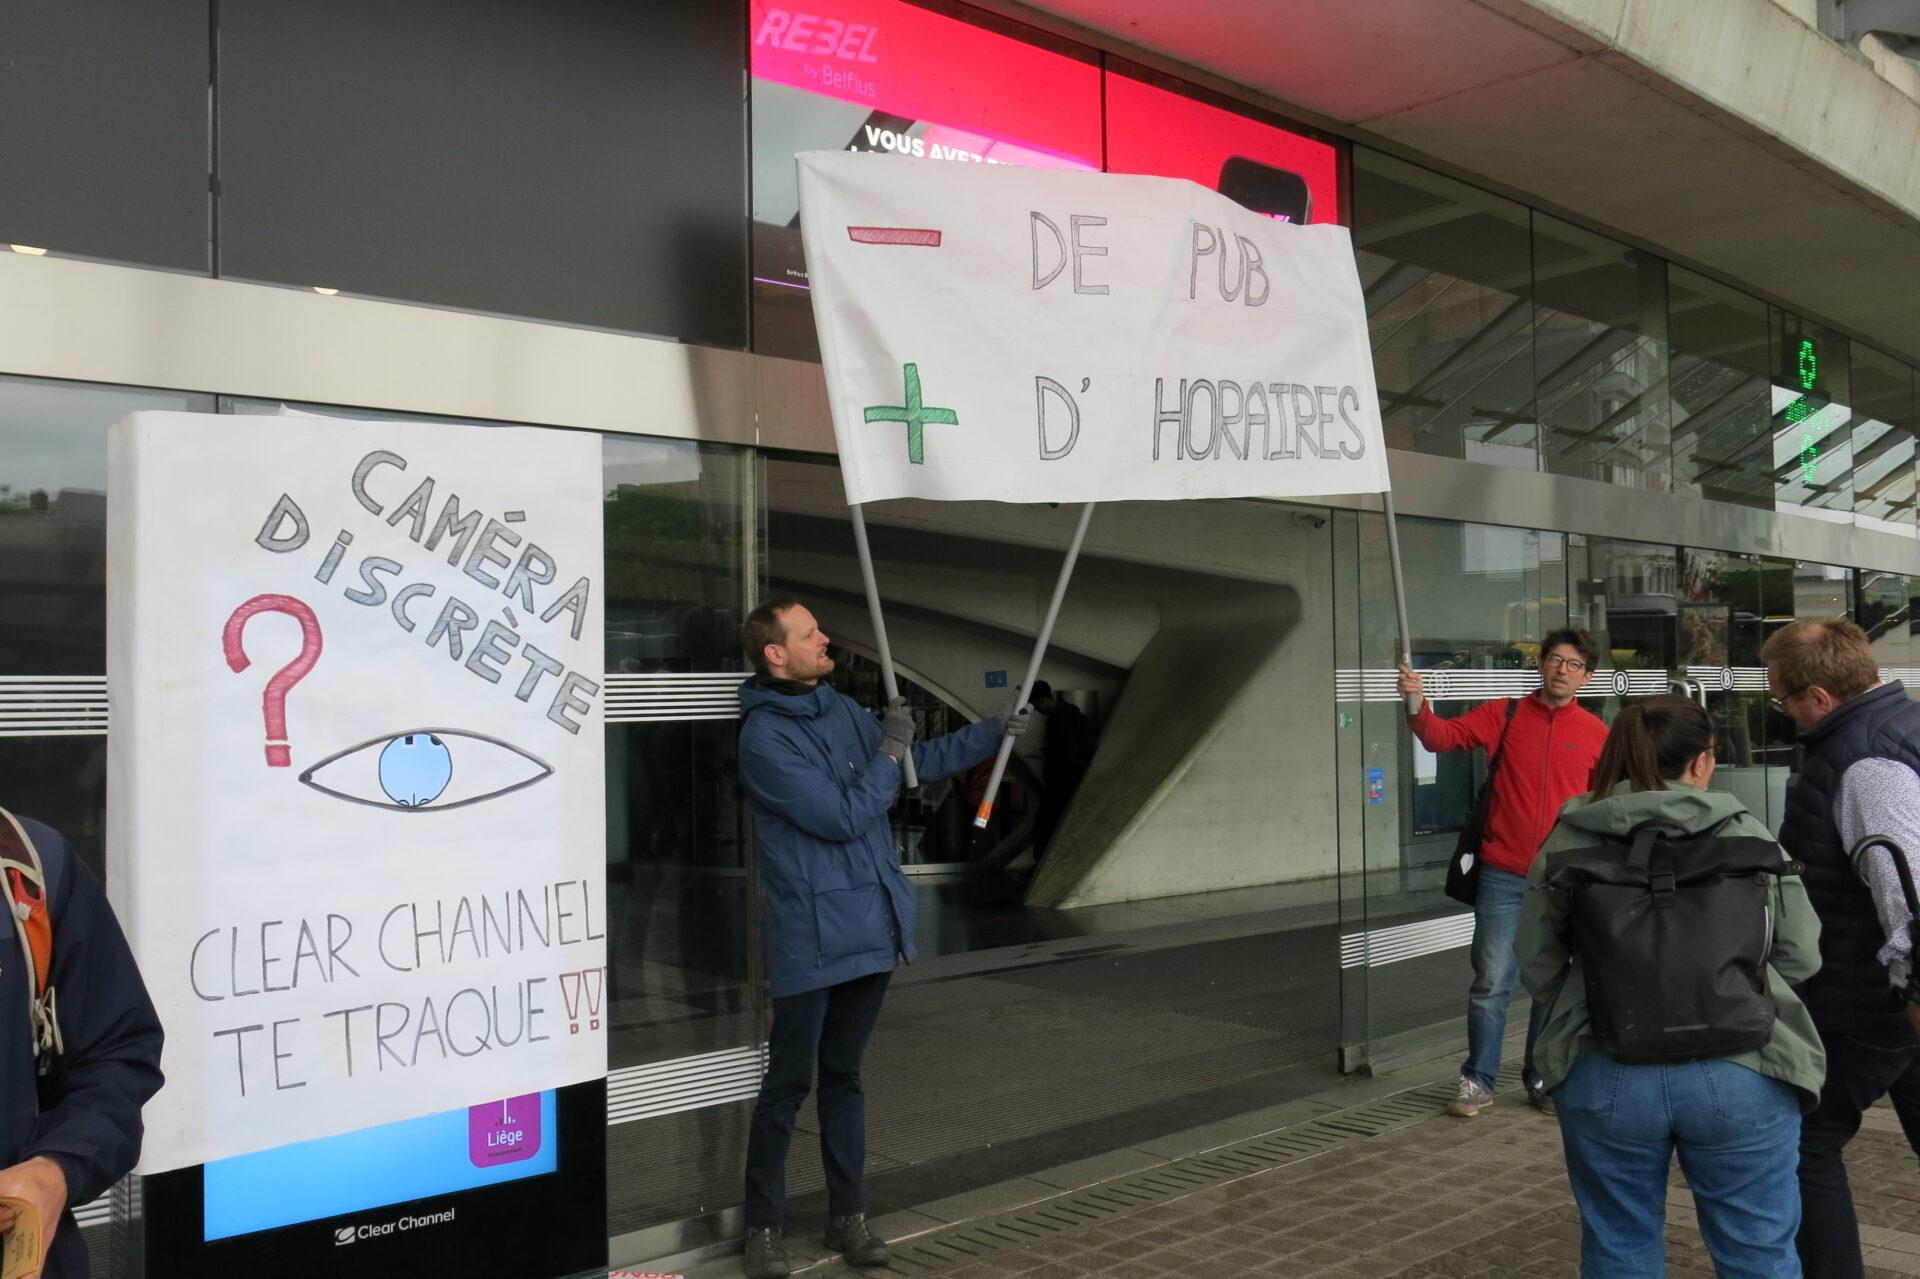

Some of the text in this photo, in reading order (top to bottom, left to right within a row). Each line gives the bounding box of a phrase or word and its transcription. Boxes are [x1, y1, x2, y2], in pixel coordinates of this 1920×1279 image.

[822, 64, 877, 98] Belfius
[865, 124, 925, 158] VOUS
[1030, 211, 1110, 296] DE
[1190, 222, 1271, 307] PUB
[1152, 378, 1366, 462] HORAIRES
[351, 449, 591, 642] CAMÉRA
[189, 880, 606, 1002] CLEAR CHANNEL
[213, 1018, 308, 1098] TE
[487, 1129, 524, 1147] Liège
[357, 1207, 456, 1240] Clear Channel
